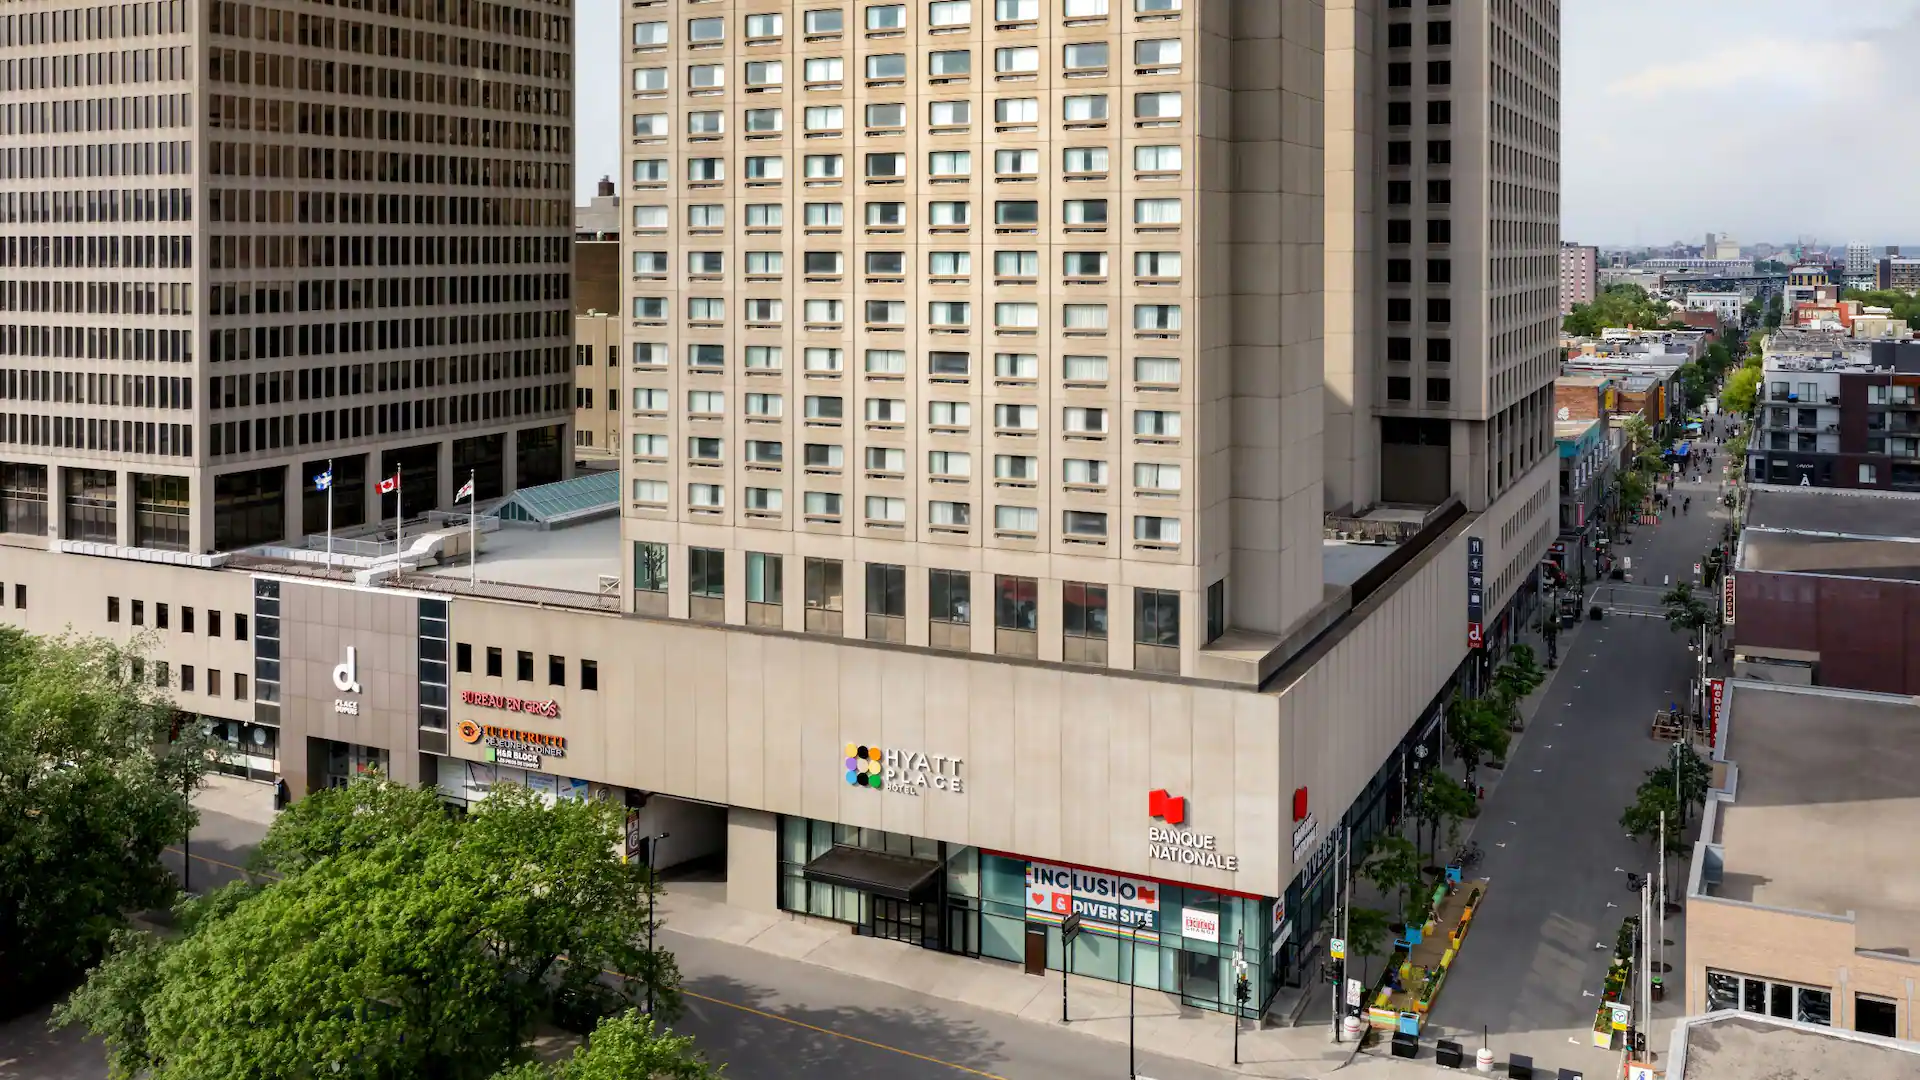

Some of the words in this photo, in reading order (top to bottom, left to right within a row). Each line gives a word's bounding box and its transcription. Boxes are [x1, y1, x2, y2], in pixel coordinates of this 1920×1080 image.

[462, 691, 504, 709] BUREAU
[507, 698, 520, 711] EN
[523, 700, 557, 717] GROS
[483, 725, 517, 742] TUTTI
[520, 731, 563, 748] FRUTTI
[496, 749, 512, 759] H&R
[513, 751, 538, 762] BLOCK
[886, 748, 962, 776] HYATT
[886, 769, 962, 792] PLACE
[887, 783, 916, 795] HOTEL
[1149, 827, 1214, 850] BANQUE
[1149, 843, 1238, 871] NATIONALE
[1072, 900, 1153, 927] DIVERSITÉ
